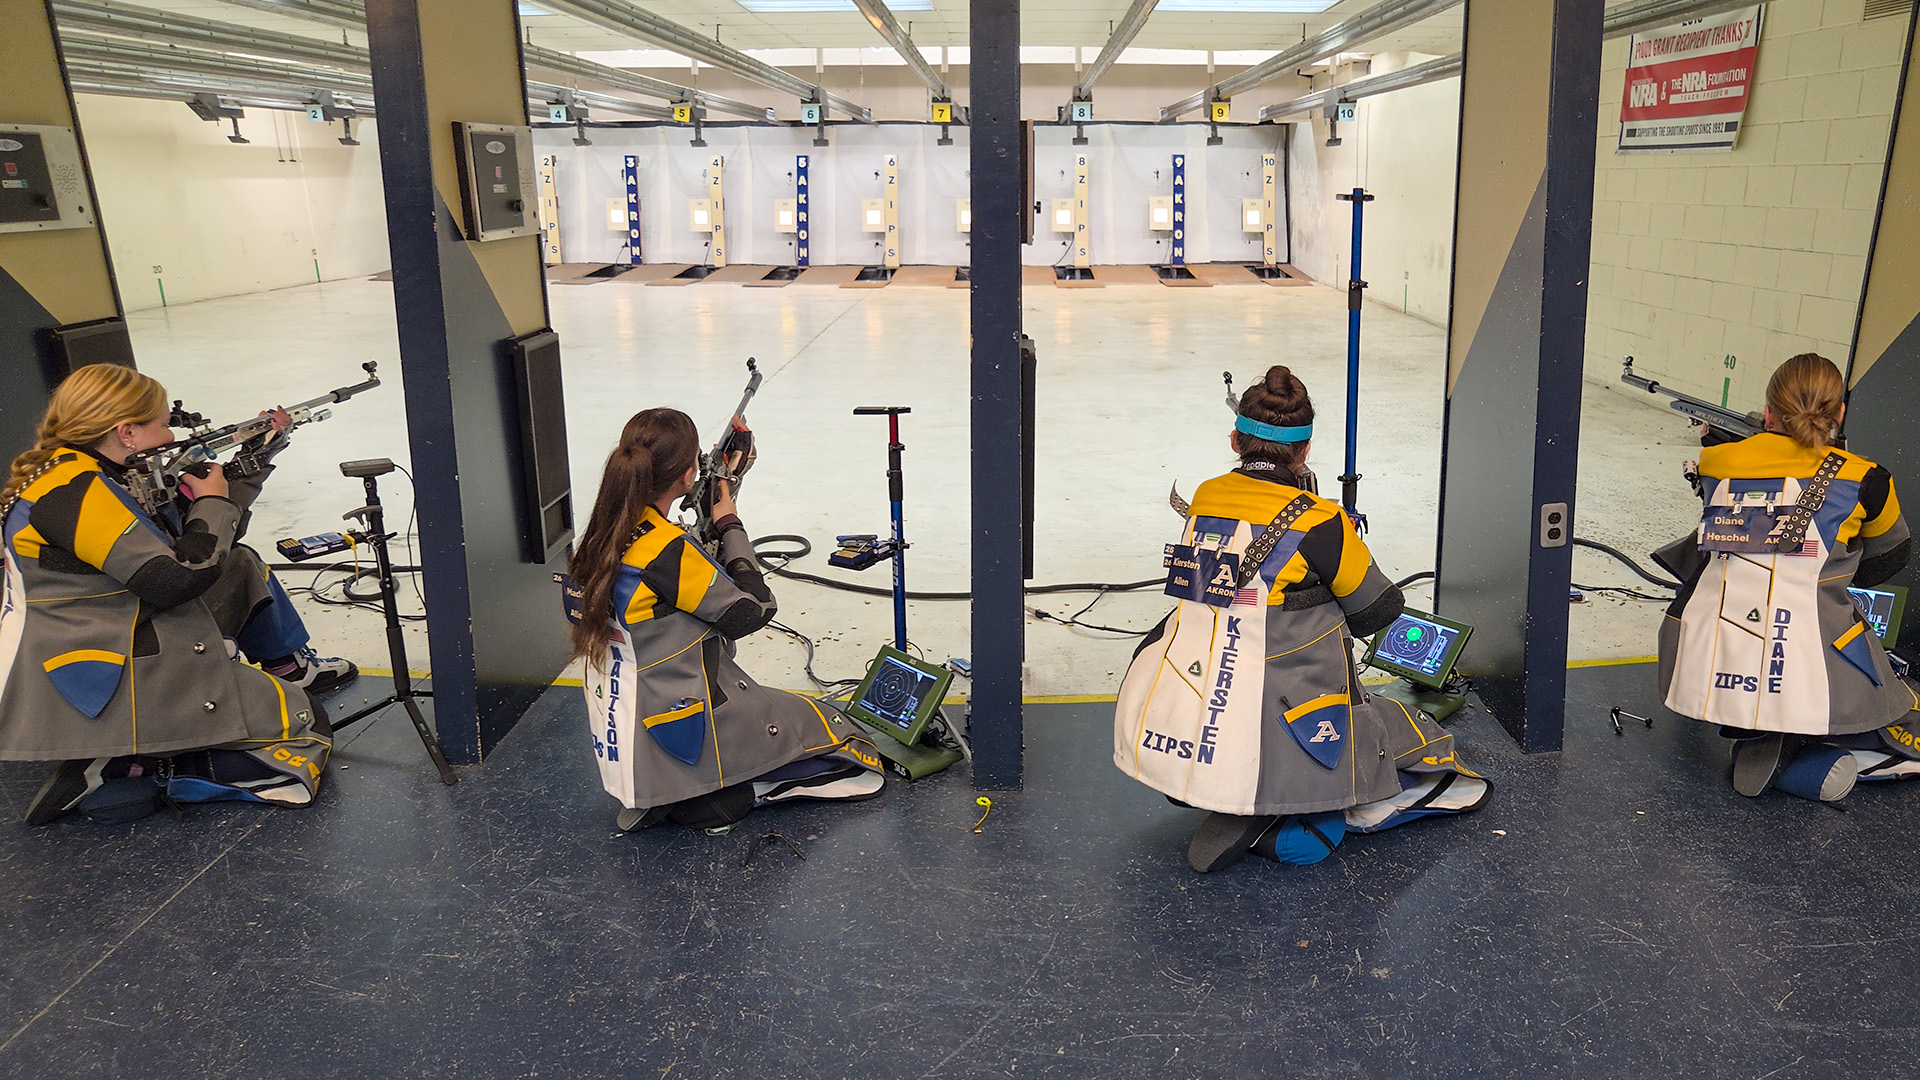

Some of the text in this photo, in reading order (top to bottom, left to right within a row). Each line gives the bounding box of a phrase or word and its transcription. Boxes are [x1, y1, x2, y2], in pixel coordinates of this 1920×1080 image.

[1653, 36, 1677, 56] GRANT
[1674, 28, 1712, 53] RECIPIENT
[1711, 22, 1743, 46] THANKS
[1630, 68, 1747, 108] NRA & THE NRA FOUNDATION
[311, 109, 319, 120] 2
[554, 110, 562, 120] 4
[678, 108, 685, 118] 5
[807, 109, 814, 119] 6
[938, 109, 945, 118] 7
[1078, 108, 1085, 118] 8
[1217, 108, 1224, 118] 9
[1341, 108, 1353, 118] 10
[1699, 123, 1712, 134] SINCE
[1713, 122, 1724, 132] 1992
[889, 158, 895, 167] 6
[544, 158, 558, 254] 2 ZIPS
[626, 157, 640, 257] 3 AKRON
[712, 158, 722, 256] 4 ZIPS
[798, 158, 808, 258] 5 AKRON
[1078, 157, 1086, 256] 8 ZIPS
[1174, 157, 1184, 258] 9 AKRON
[1264, 158, 1275, 256] 10 ZIPS
[152, 264, 163, 274] 20
[1723, 354, 1737, 370] 40
[1714, 516, 1745, 526] Diane
[1706, 532, 1749, 543] Heschel
[1165, 545, 1175, 554] 25
[1164, 559, 1172, 567] 26
[1173, 557, 1201, 571] Kiersten
[553, 574, 563, 582] 26
[1211, 563, 1236, 588] A
[1206, 585, 1236, 598] AKRON
[1768, 608, 1792, 694] DIANE
[1714, 672, 1758, 694] ZIPS
[1196, 615, 1241, 765] KIERSTEN
[1309, 720, 1341, 743] A
[1142, 729, 1195, 760] ZIPS
